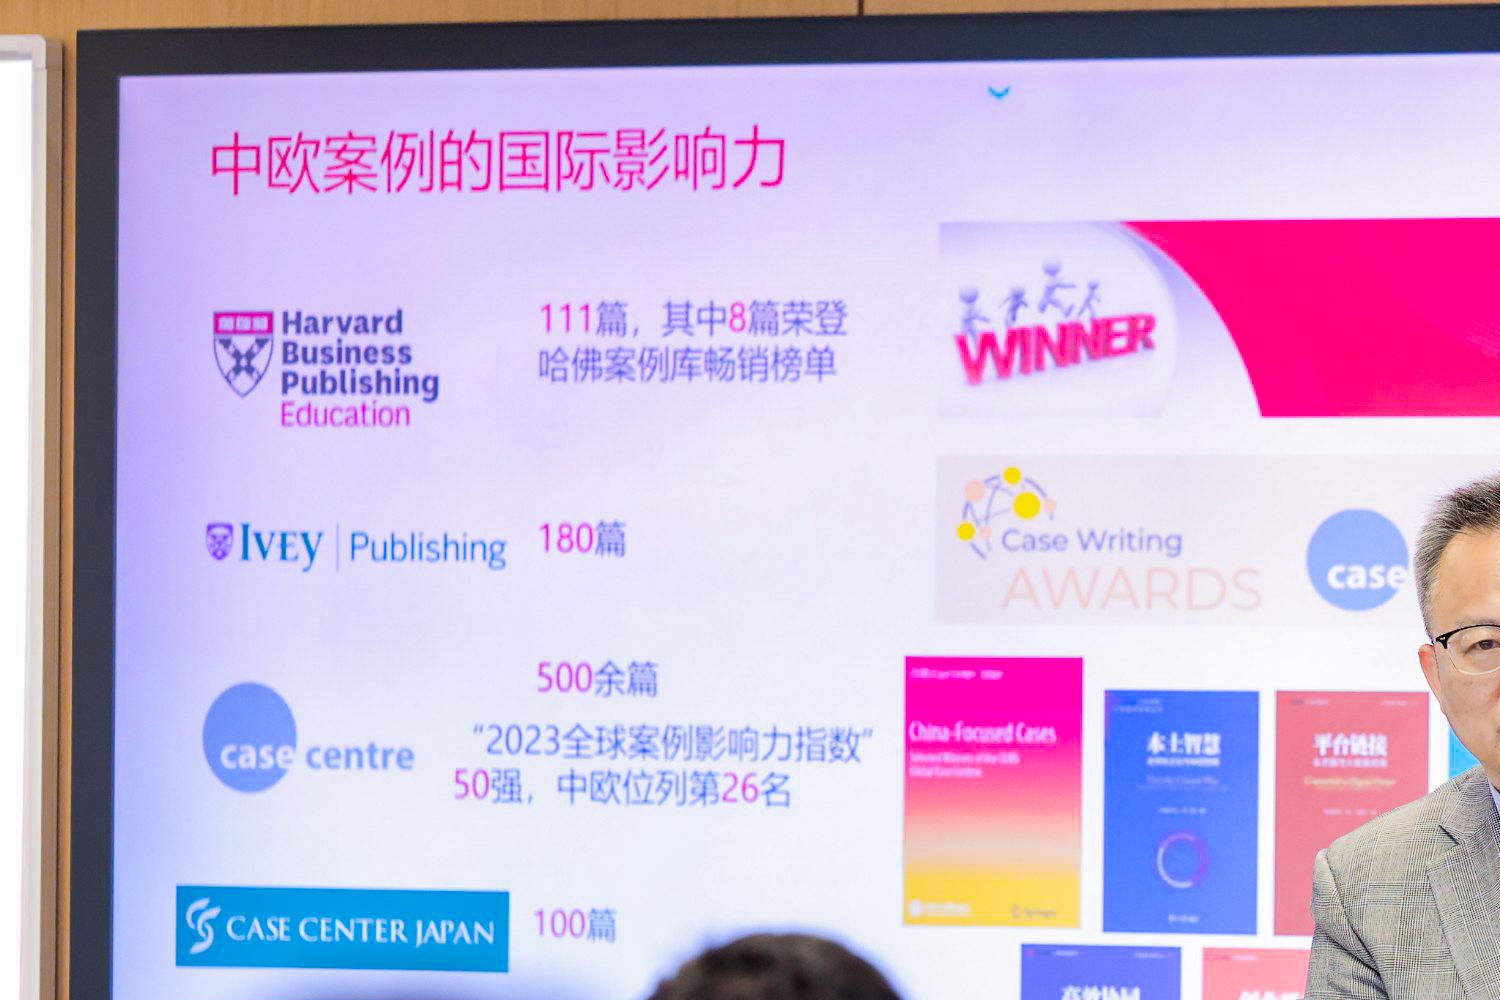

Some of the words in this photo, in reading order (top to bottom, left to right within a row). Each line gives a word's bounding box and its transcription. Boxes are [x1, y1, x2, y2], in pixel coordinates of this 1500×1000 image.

[212, 125, 784, 196] 中欧案例的国际影响力
[283, 309, 402, 334] Harvard
[541, 300, 847, 337] 111篇，其中8篇荣登
[283, 340, 411, 364] Business
[539, 346, 835, 382] 哈佛案例库畅销榜单
[955, 312, 1157, 386] WINNER
[282, 368, 438, 402] Publishing
[281, 401, 409, 426] Education
[351, 532, 505, 567] Publishing
[540, 521, 625, 557] 180篇
[1002, 528, 1068, 551] Case
[1077, 528, 1182, 558] Writing
[1002, 567, 1262, 611] AWARDS
[1327, 564, 1408, 590] case
[539, 661, 657, 697] 500余篇
[220, 741, 294, 771] case
[306, 742, 414, 770] centre
[474, 724, 872, 762] “2023全球案例影响力指数”
[455, 769, 790, 807] 50强，中欧位列第26名
[227, 916, 290, 941] CASE
[299, 918, 407, 942] CENTER
[416, 920, 493, 947] JAPAN
[535, 908, 616, 942] 100篇
